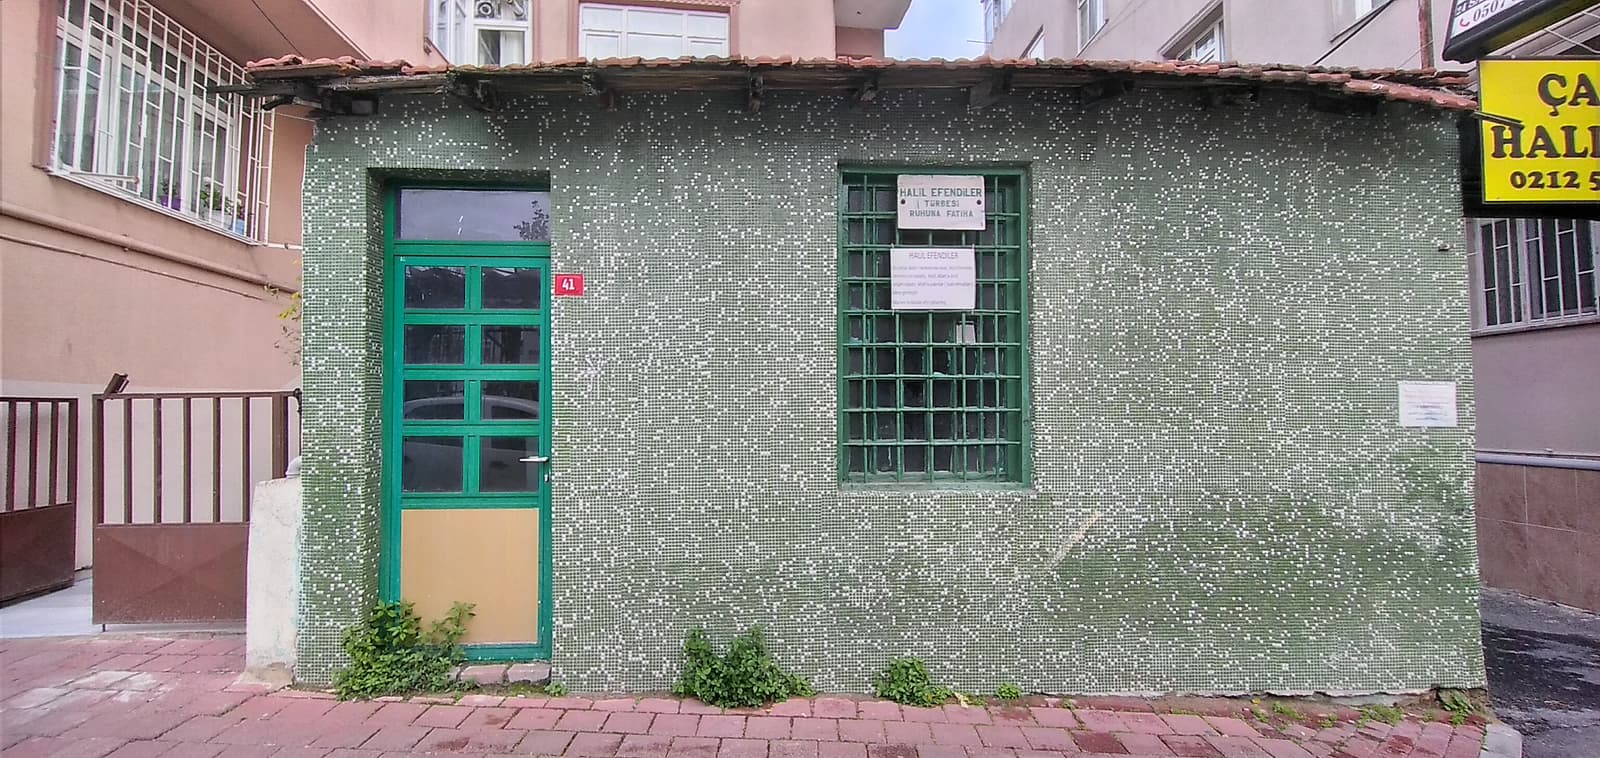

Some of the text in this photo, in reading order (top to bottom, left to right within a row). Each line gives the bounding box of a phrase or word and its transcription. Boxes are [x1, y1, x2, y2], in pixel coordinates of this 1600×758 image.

[1538, 73, 1600, 117] ÇA
[1510, 171, 1580, 189] 0212
[561, 278, 575, 290] 41
